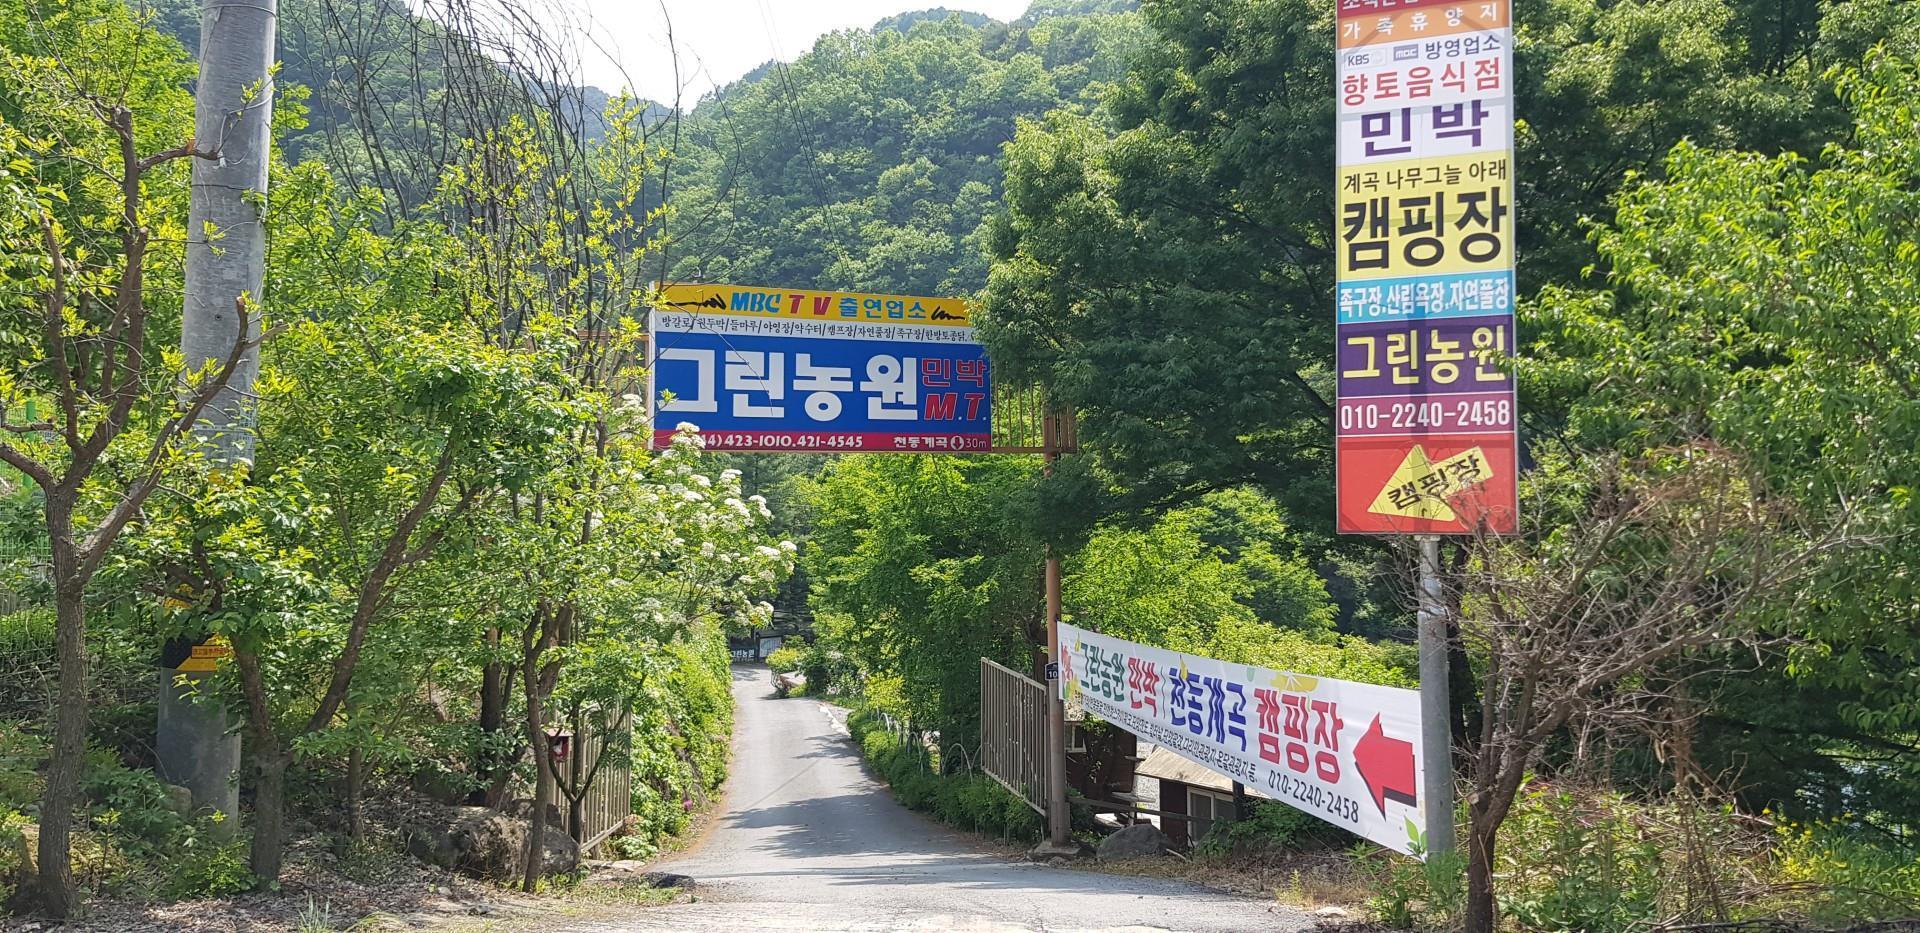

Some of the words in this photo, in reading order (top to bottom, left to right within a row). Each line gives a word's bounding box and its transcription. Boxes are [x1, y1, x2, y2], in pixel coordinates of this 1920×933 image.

[1347, 53, 1370, 67] KBS
[1425, 35, 1500, 60] 방영업소
[1343, 57, 1501, 106] 향토음식점
[1361, 100, 1489, 157] 민박
[1344, 172, 1380, 193] 계곡
[1386, 164, 1463, 190] 나무그늘
[1468, 159, 1506, 182] 아래
[1343, 187, 1507, 272] 캠핑장
[731, 292, 782, 313] MBC
[838, 297, 927, 319] 출연업소
[1343, 325, 1506, 385] 그린농원
[657, 348, 918, 422] 그린농원
[921, 359, 988, 388] 민박
[1340, 400, 1511, 430] 010-2240-2458
[893, 436, 948, 449] 천동계곡
[965, 438, 987, 448] 30m
[1387, 454, 1481, 511] 캠핑장
[1048, 671, 1058, 679] 10
[1080, 642, 1126, 702] 그린농원
[1127, 656, 1160, 718] 민박
[1169, 667, 1247, 753] 천동계곡
[1254, 687, 1344, 785] 캠핑장
[1268, 770, 1359, 823] 010-2240-2458
